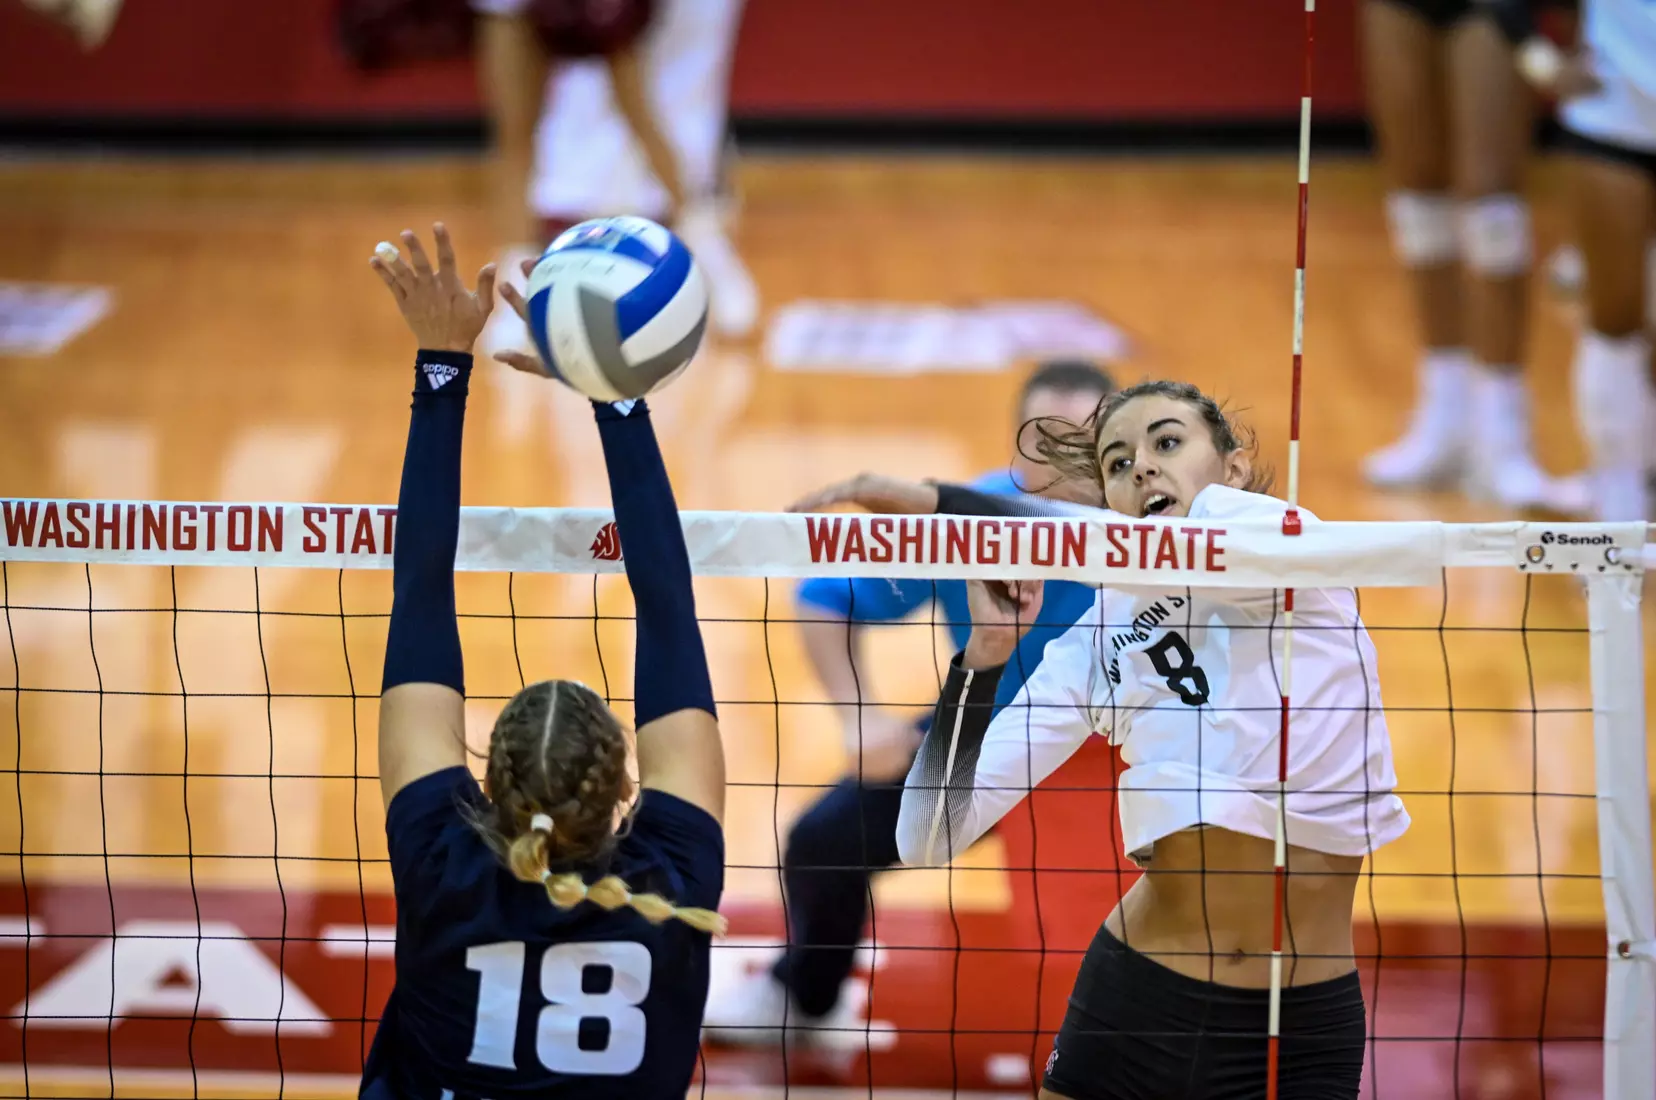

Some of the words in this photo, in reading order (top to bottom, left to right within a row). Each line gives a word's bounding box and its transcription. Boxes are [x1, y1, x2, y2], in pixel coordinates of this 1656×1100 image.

[423, 363, 459, 376] adidas
[3, 501, 284, 552] WASHINGTON
[302, 506, 398, 554] STAT
[805, 517, 1087, 567] WASHINGTON
[1106, 524, 1227, 571] STATE
[1557, 533, 1614, 545] Senoh
[1141, 630, 1210, 706] 8
[465, 940, 652, 1075] 18
